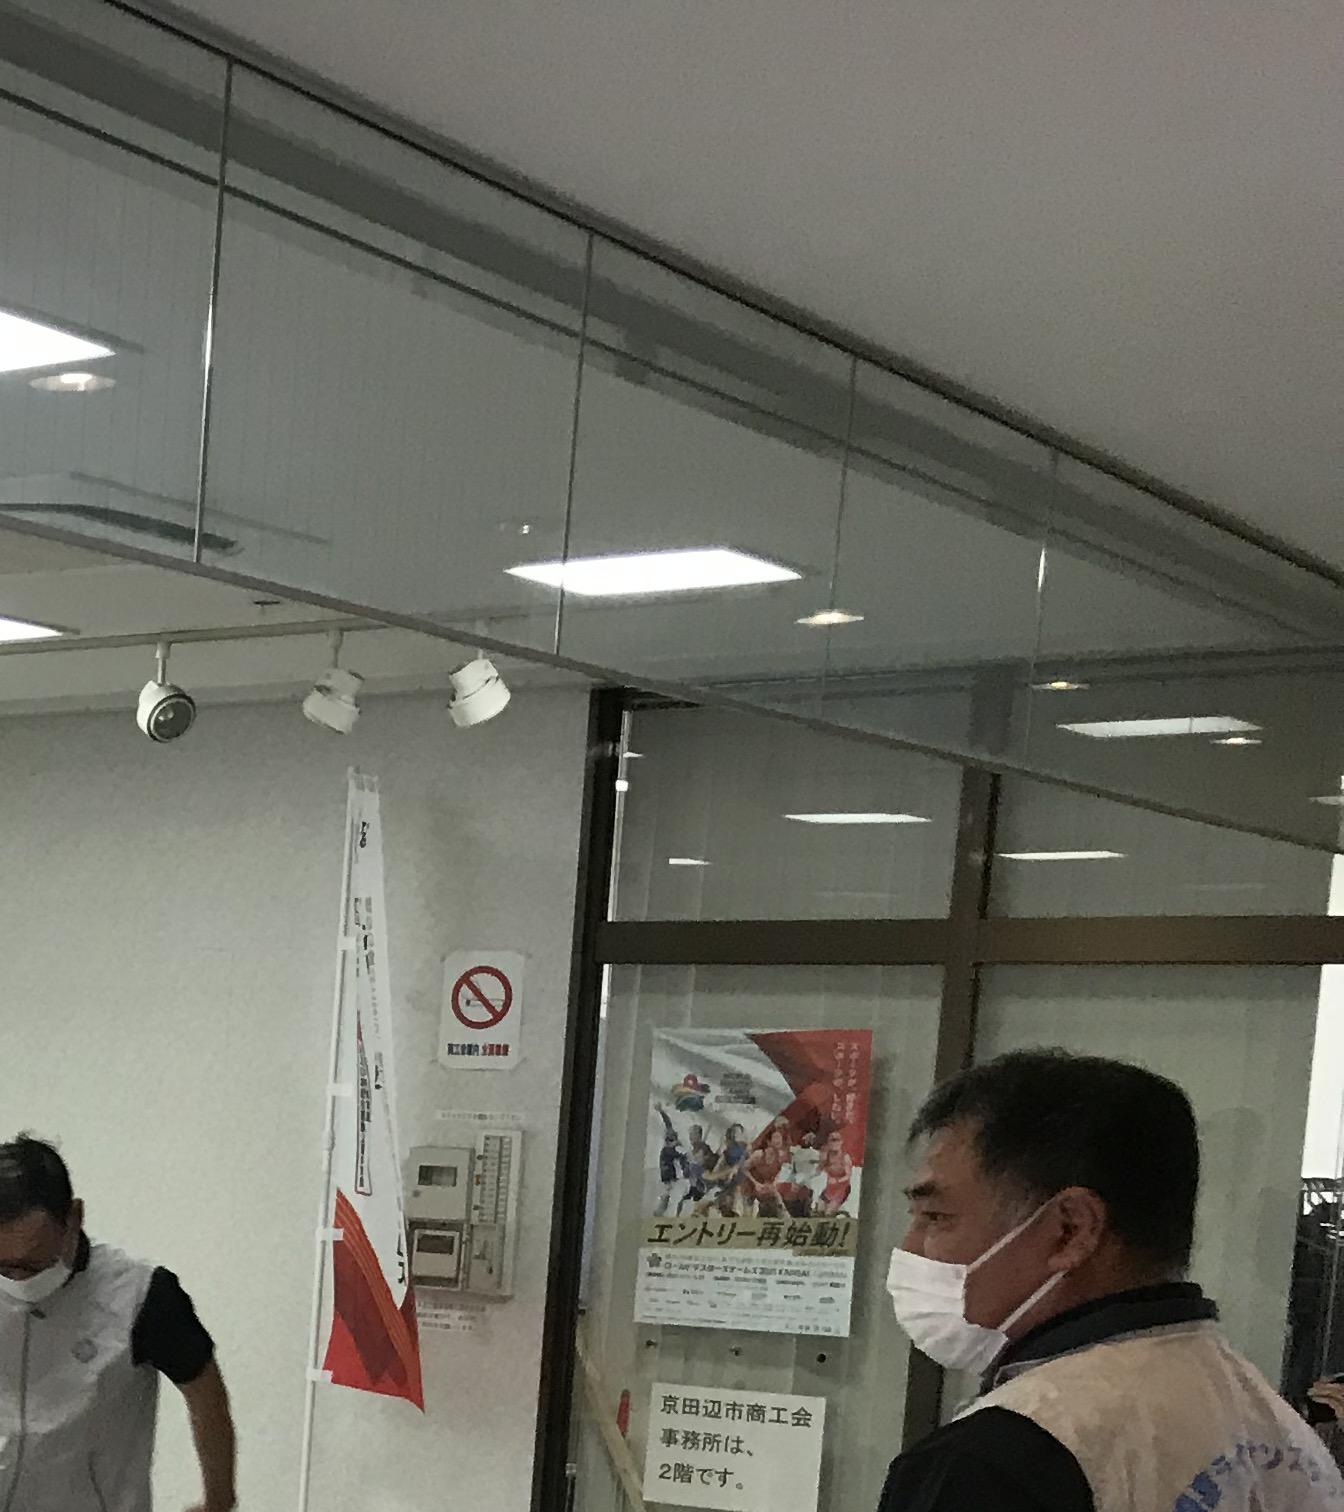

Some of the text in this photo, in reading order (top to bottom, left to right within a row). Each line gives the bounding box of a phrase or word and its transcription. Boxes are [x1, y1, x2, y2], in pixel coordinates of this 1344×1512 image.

[660, 1394, 813, 1429] 京田辺市商工会
[659, 1427, 754, 1457] 事務所は、
[657, 1462, 744, 1490] 2階です。
